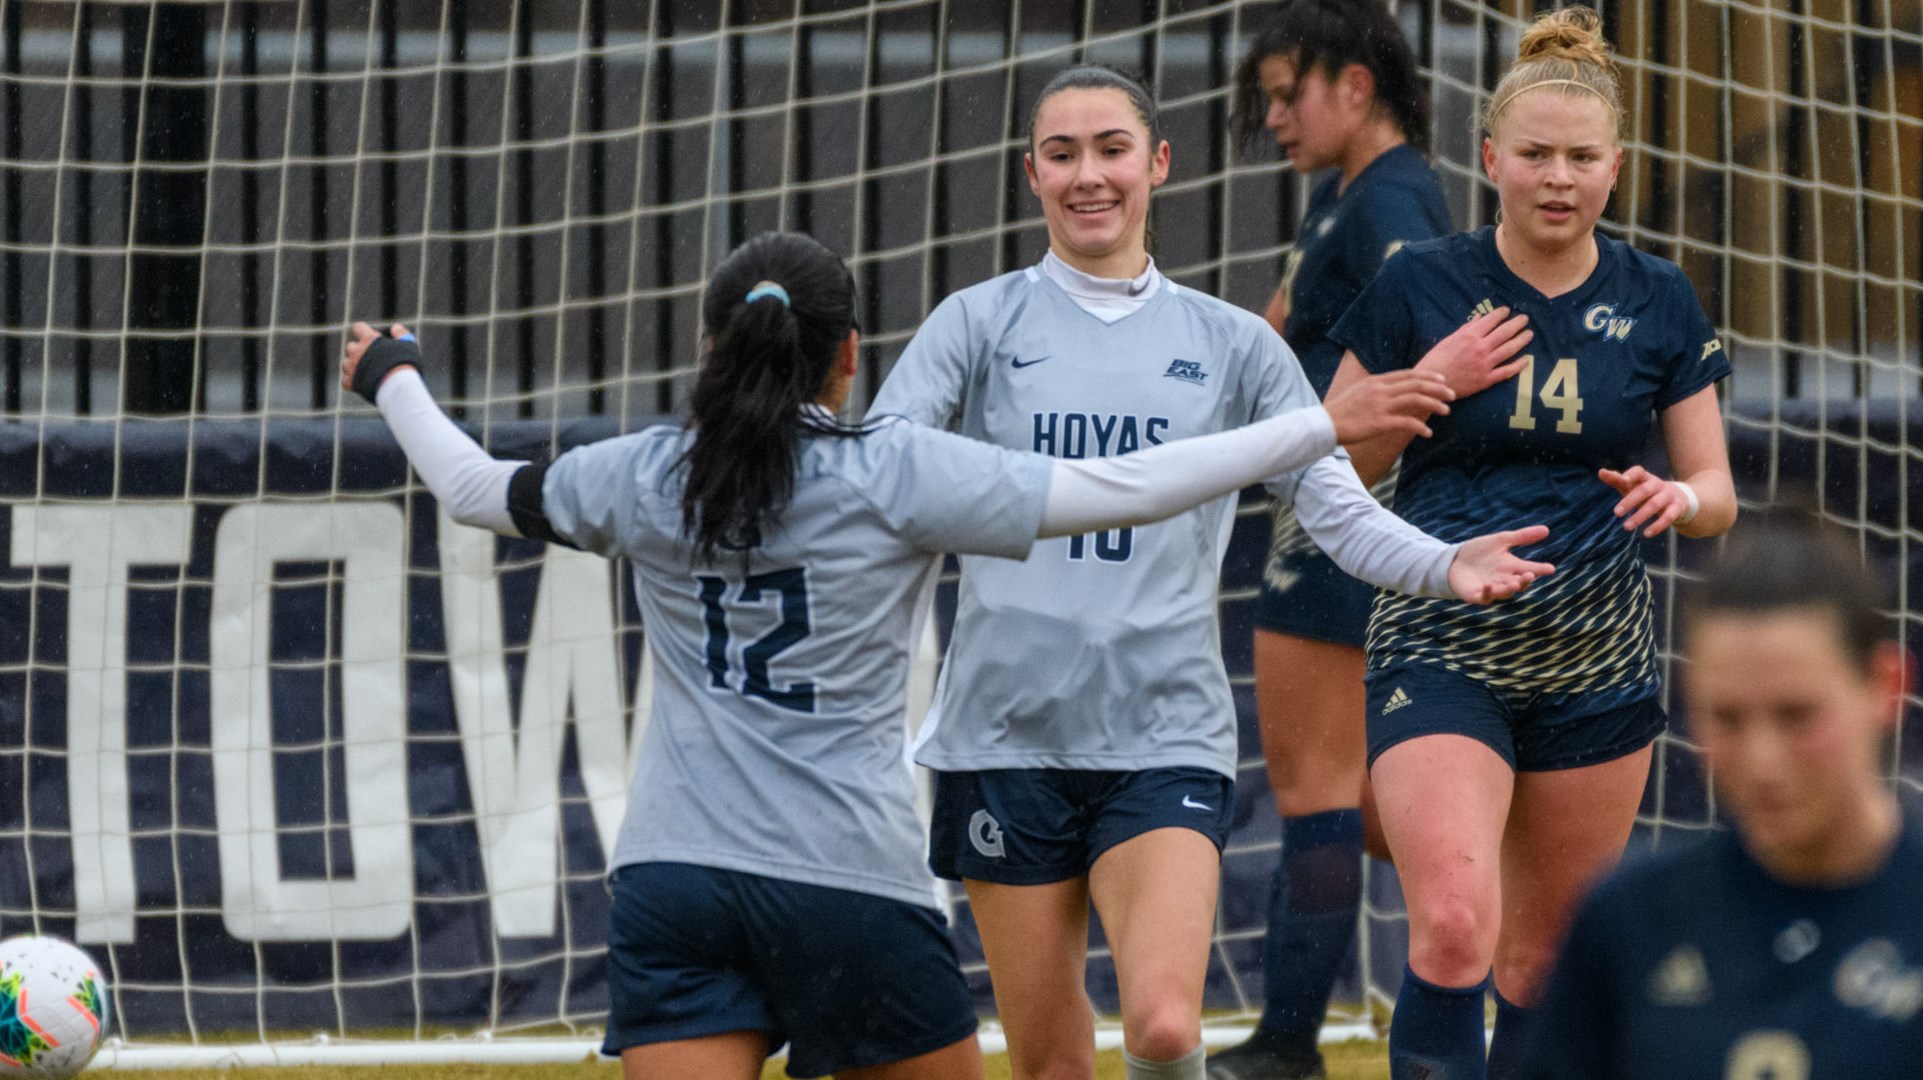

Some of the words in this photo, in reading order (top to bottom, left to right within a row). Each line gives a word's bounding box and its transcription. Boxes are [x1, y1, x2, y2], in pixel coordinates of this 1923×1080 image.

[1583, 302, 1637, 342] GW
[1166, 366, 1209, 380] EAST
[1171, 359, 1202, 370] BIG
[1509, 354, 1584, 434] 14
[697, 566, 816, 713] 12
[10, 502, 660, 944] TOW
[968, 809, 1006, 858] G
